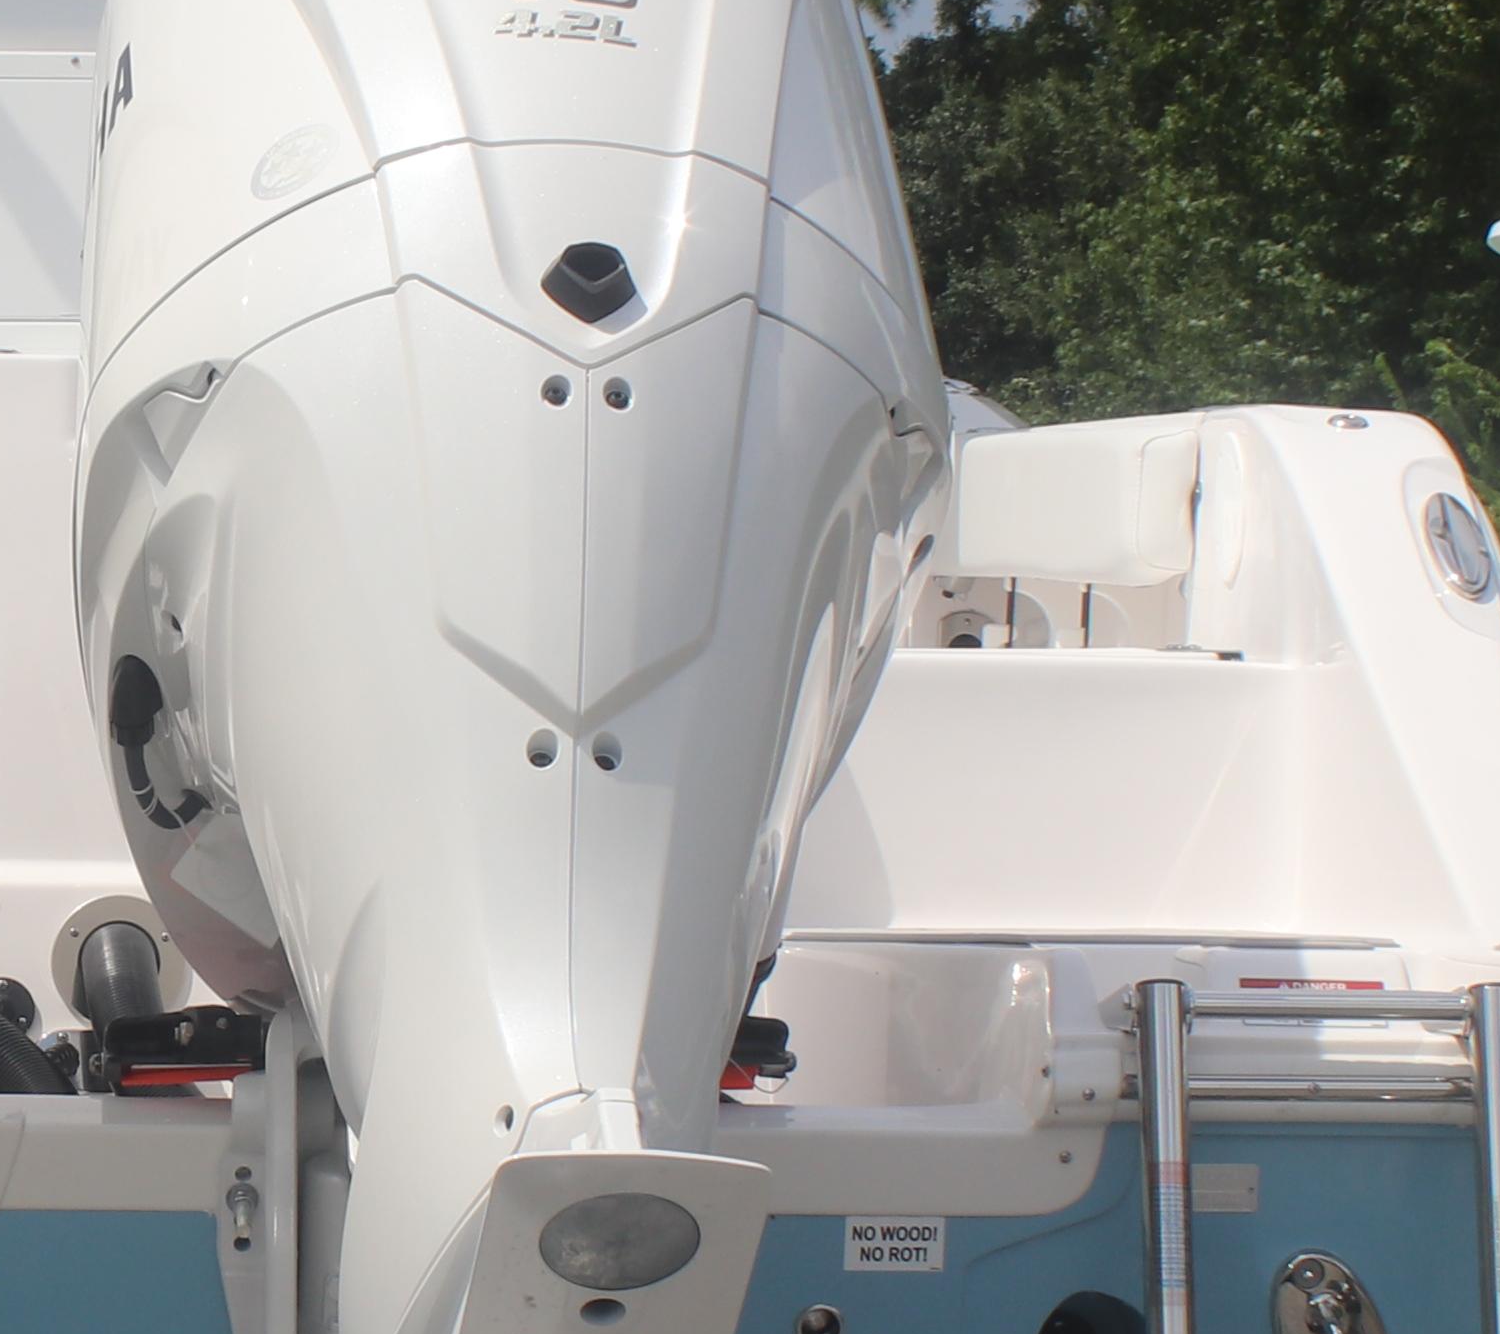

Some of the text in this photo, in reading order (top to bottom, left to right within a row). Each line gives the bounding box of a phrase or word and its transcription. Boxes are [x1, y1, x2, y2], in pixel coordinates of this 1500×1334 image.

[491, 8, 638, 47] 4.2L
[852, 1225, 938, 1243] NO WOOD!
[859, 1246, 928, 1263] NO ROT!
